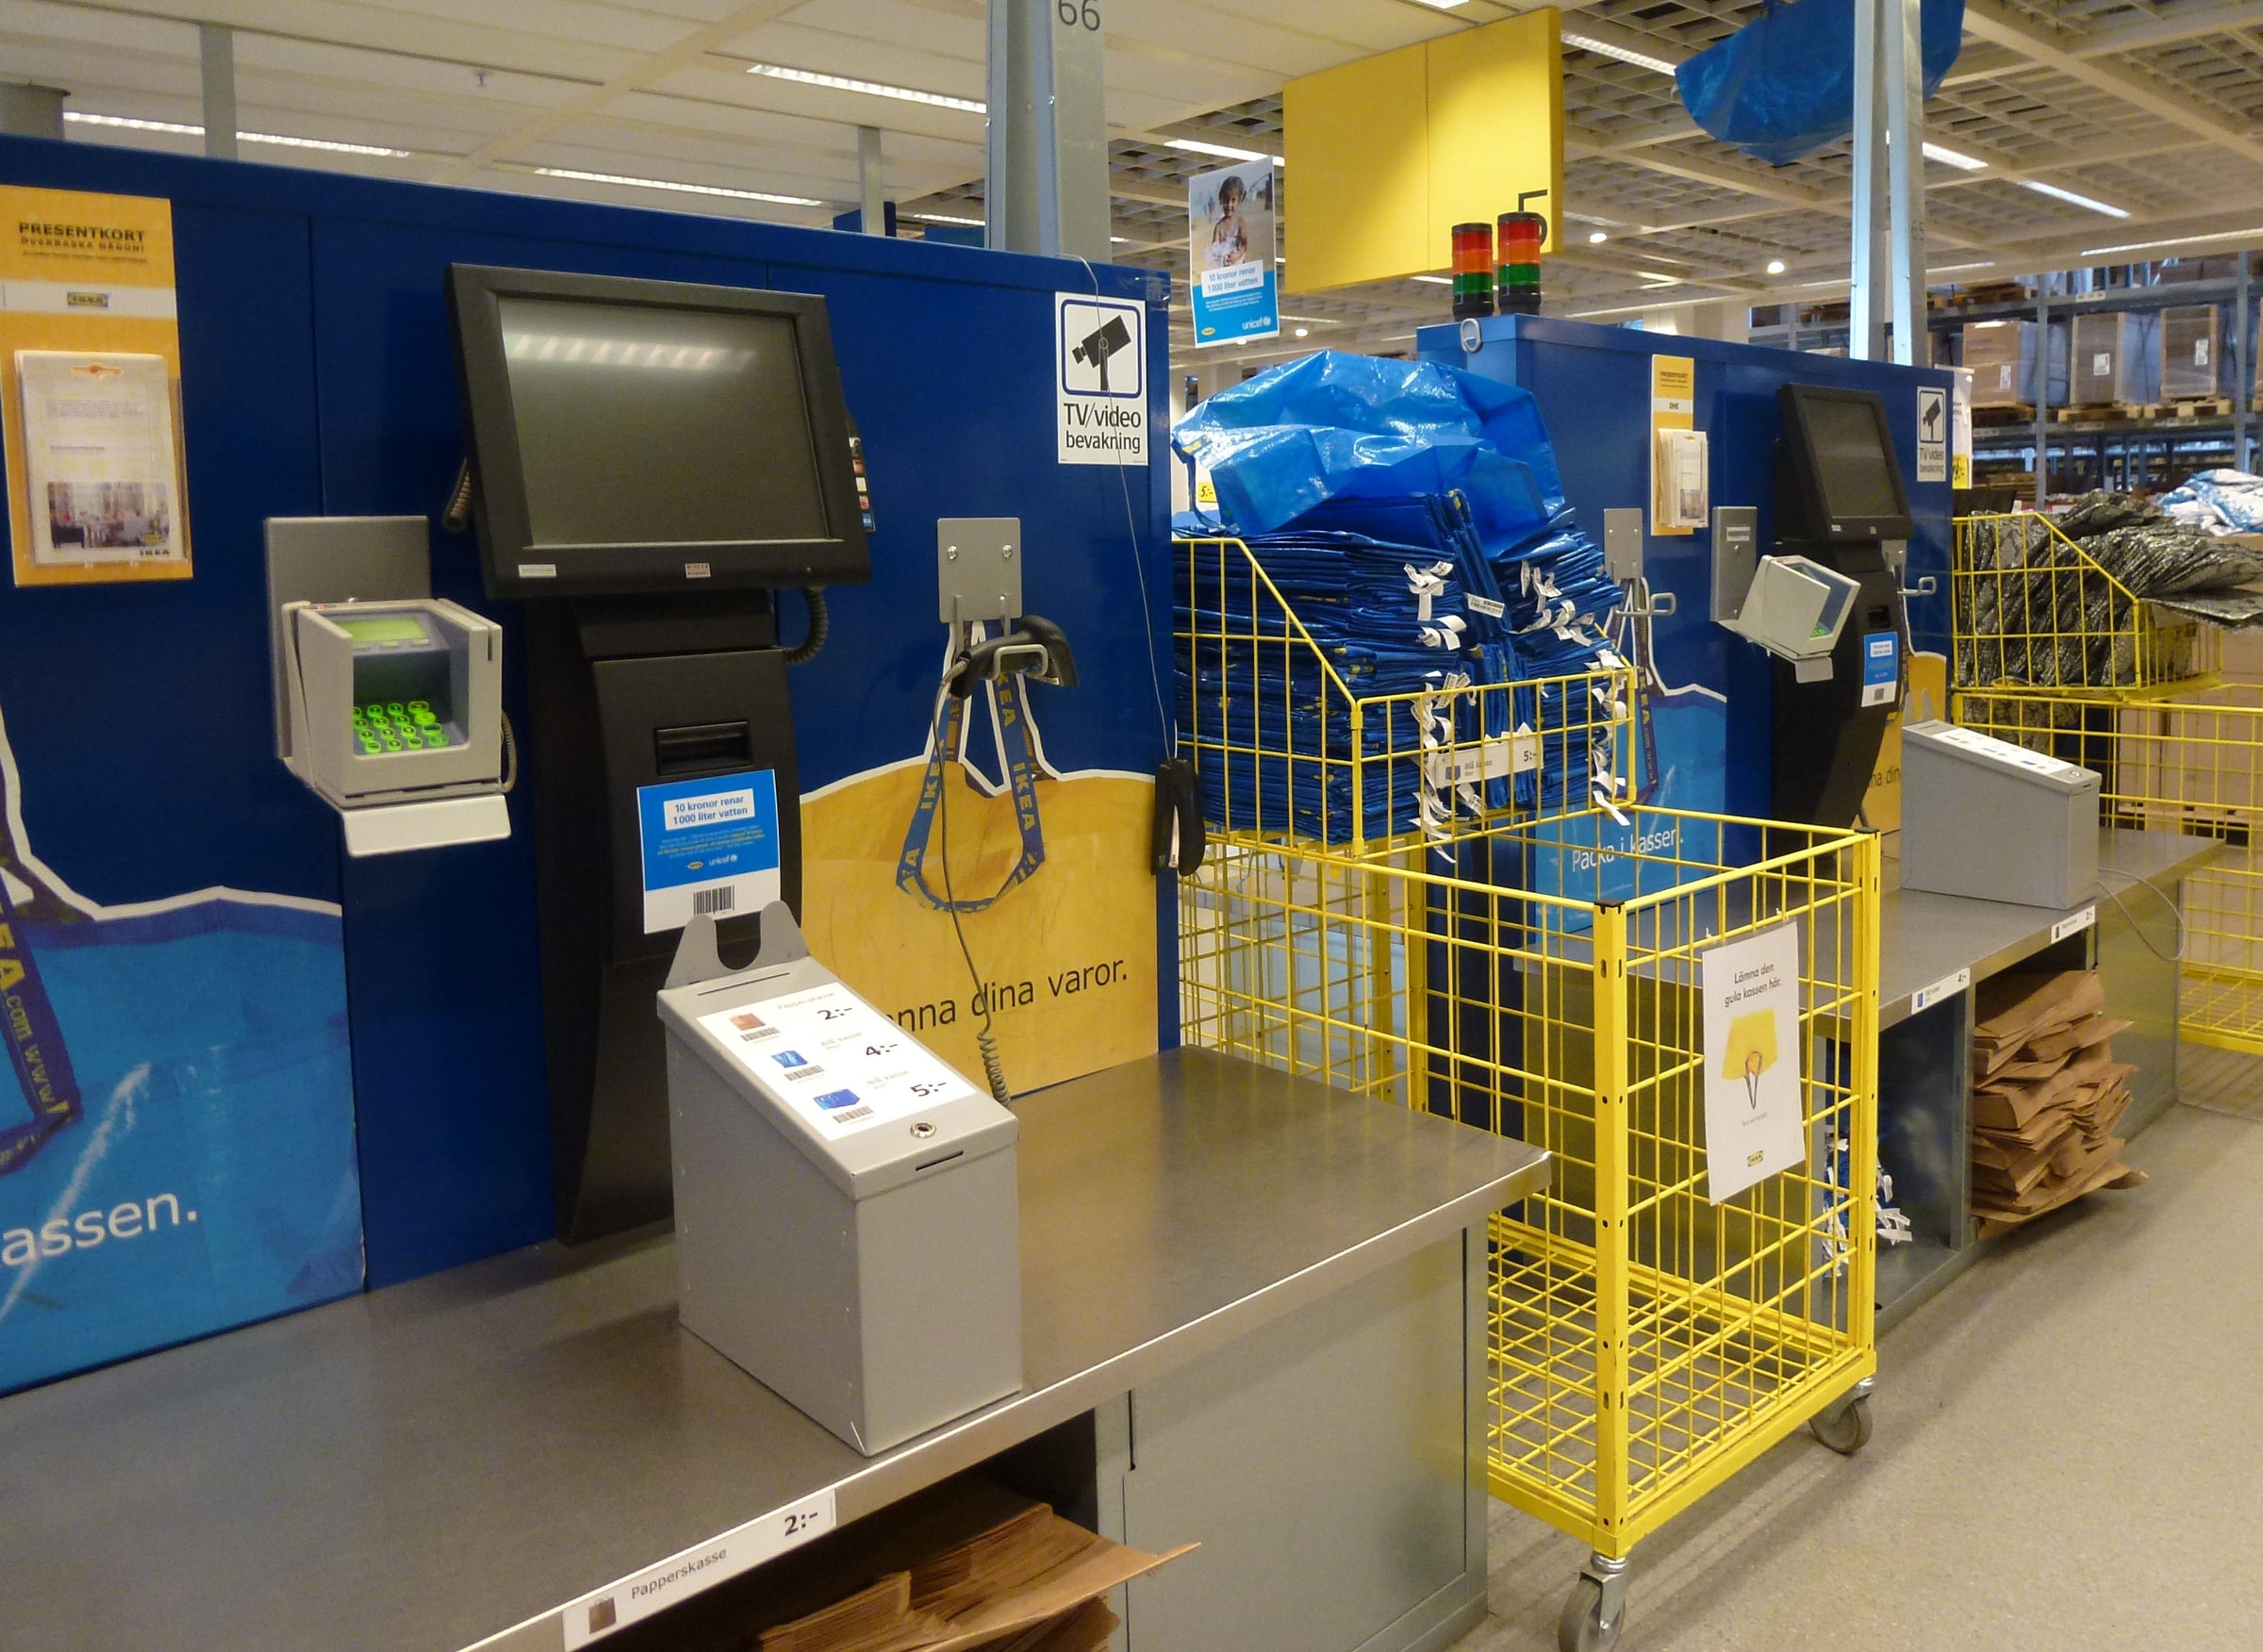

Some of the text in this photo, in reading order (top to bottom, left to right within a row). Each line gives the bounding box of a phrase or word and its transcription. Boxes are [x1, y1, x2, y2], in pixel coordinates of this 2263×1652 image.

[1058, 0, 1100, 31] 66
[19, 222, 146, 242] PRESENTKORT
[1064, 401, 1141, 428] TV/video
[1066, 430, 1141, 454] bevakning
[675, 796, 744, 813] 10 kronor renar
[1013, 762, 1035, 831] IKEA
[698, 812, 717, 821] liter
[719, 807, 748, 818] vatten
[1734, 963, 1774, 983] Lämna den
[971, 982, 1034, 1016] dina
[1048, 959, 1127, 997] varor.
[1725, 991, 1742, 1007] gula
[1743, 983, 1767, 999] kassen
[817, 1007, 852, 1020] 2:-
[866, 1043, 899, 1056] 4:-
[910, 1082, 947, 1097] 5:-
[0, 1193, 198, 1267] assen.
[631, 1512, 818, 1598] Papperskasse 2:-
